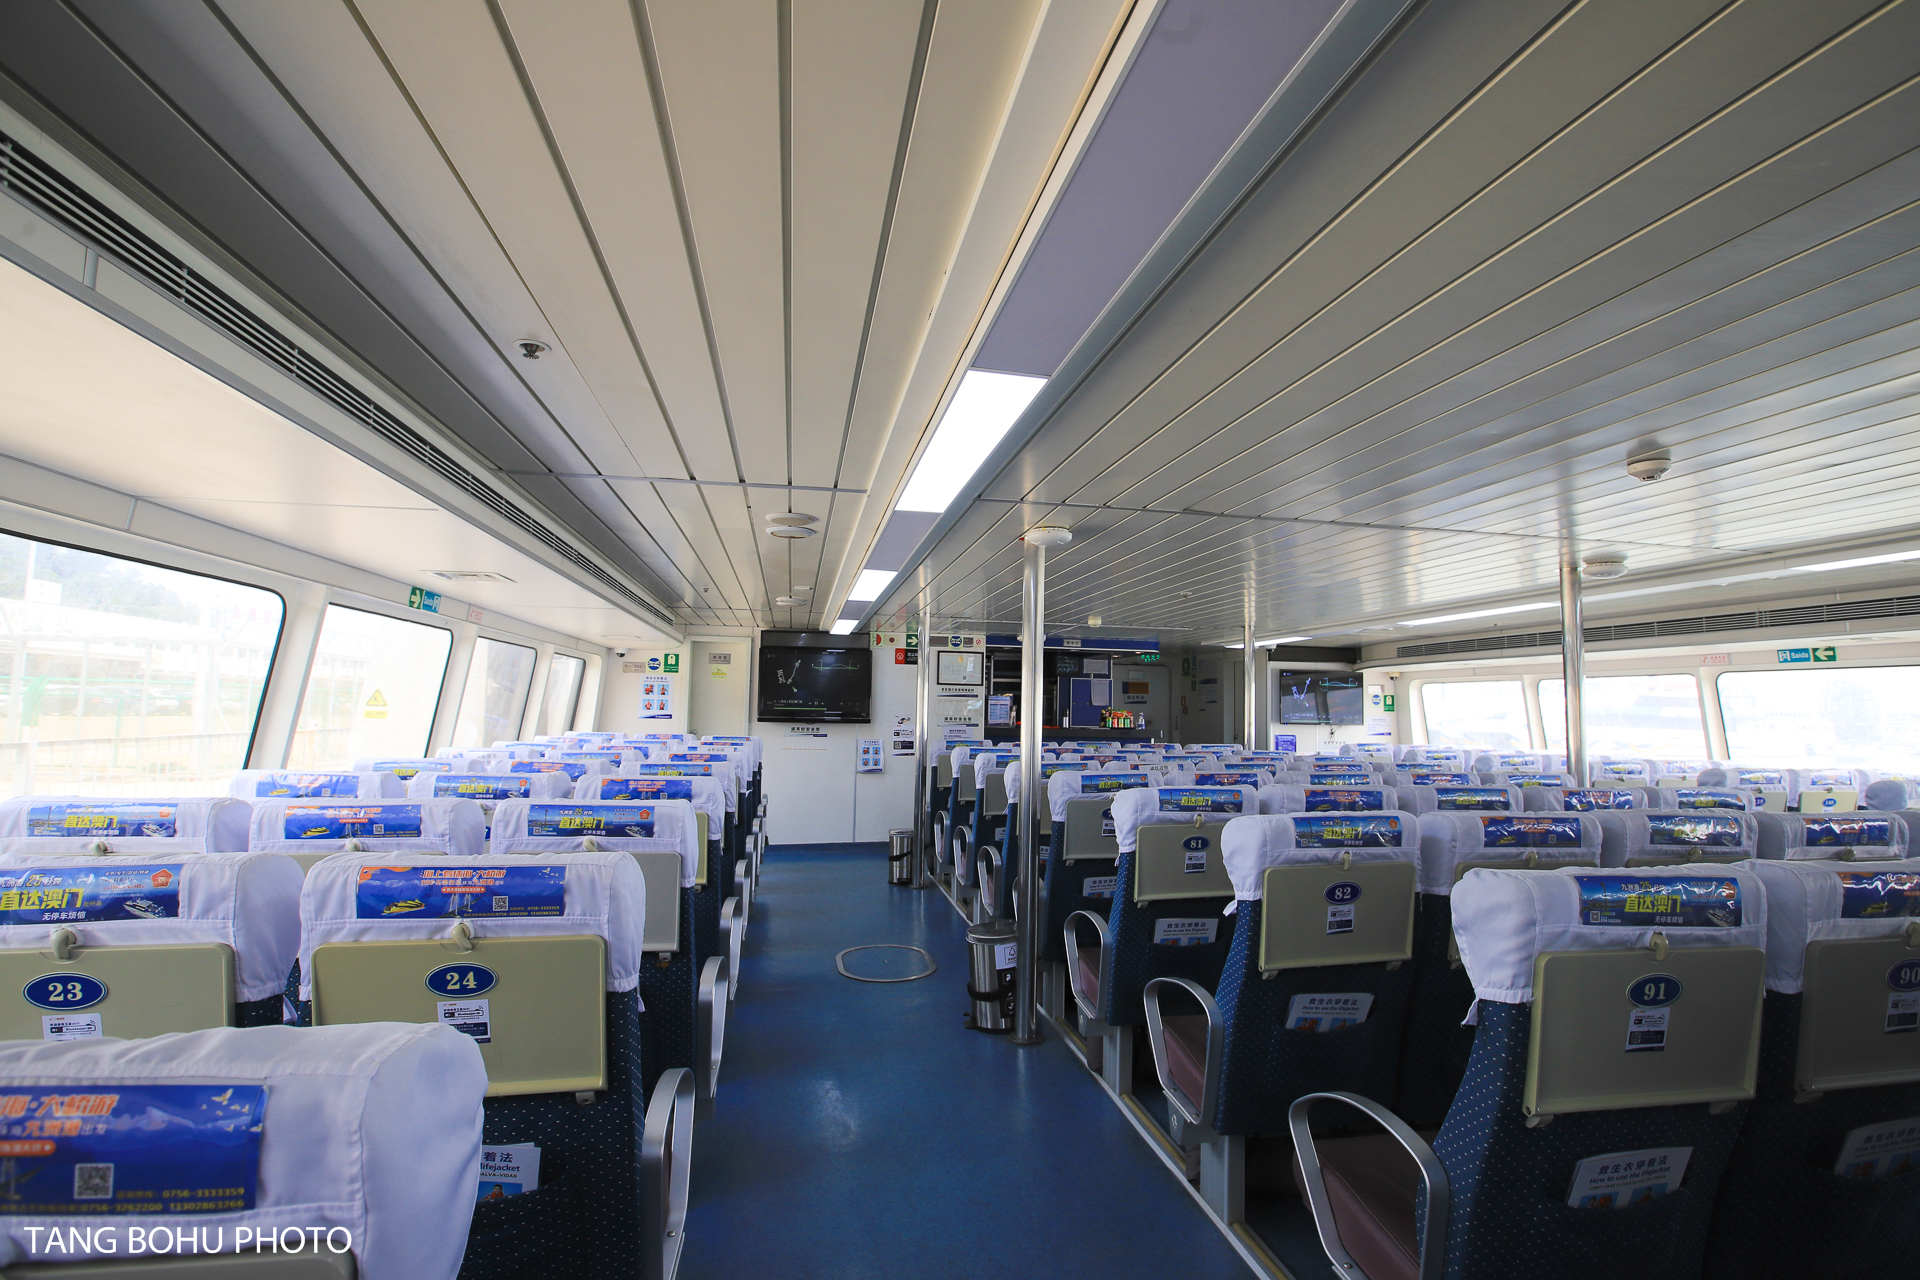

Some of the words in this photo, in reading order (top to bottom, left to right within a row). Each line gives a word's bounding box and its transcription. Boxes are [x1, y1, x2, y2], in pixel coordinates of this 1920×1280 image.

[558, 817, 605, 829] 直达澳门
[1190, 839, 1202, 849] 81
[25, 874, 45, 887] 25
[1639, 881, 1652, 892] 25
[0, 888, 84, 911] 直达澳门
[1335, 887, 1351, 900] 82
[1624, 895, 1681, 913] 直达澳门
[446, 971, 477, 990] 24
[1900, 966, 1920, 985] 90
[48, 982, 83, 1001] 23
[1643, 982, 1666, 1001] 91
[480, 1163, 520, 1172] lifejacket
[1598, 1155, 1669, 1176] 救生衣穿着法
[1607, 1174, 1615, 1182] to
[1629, 1171, 1641, 1179] the
[1641, 1166, 1671, 1177] lifejacket
[162, 1187, 245, 1198] 0756-3333359
